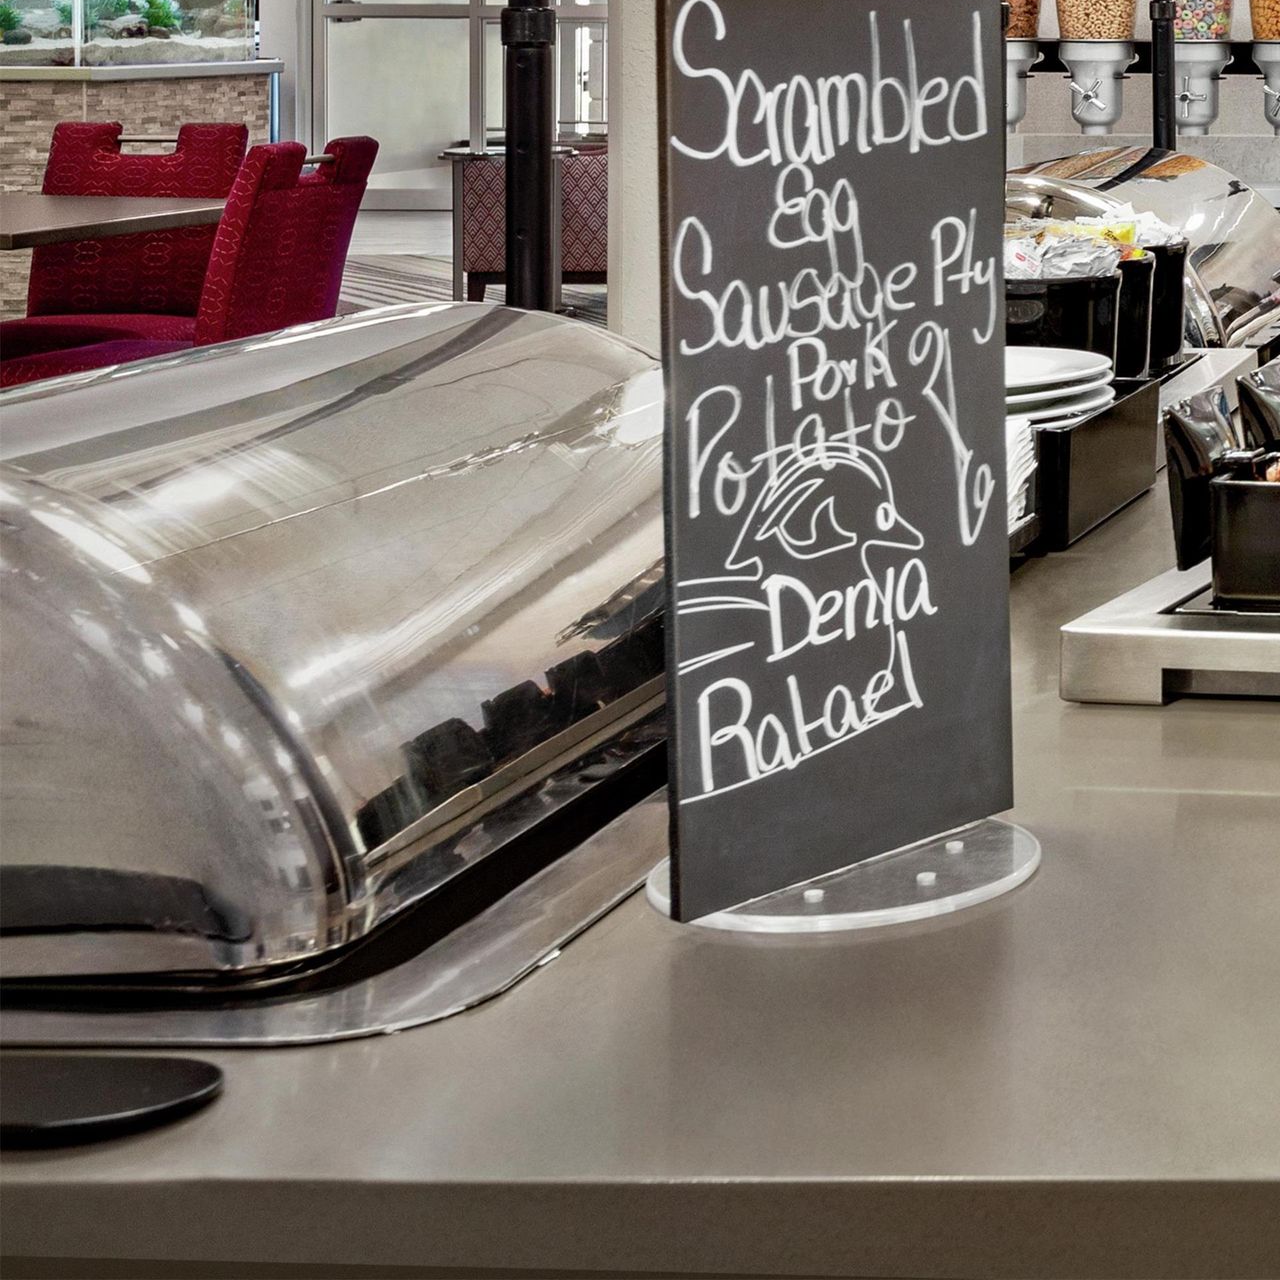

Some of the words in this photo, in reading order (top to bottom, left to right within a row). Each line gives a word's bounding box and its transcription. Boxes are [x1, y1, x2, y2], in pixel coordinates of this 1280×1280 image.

[674, 216, 917, 370] Sausage
[768, 162, 864, 290] Egg
[685, 374, 917, 519] Potato
